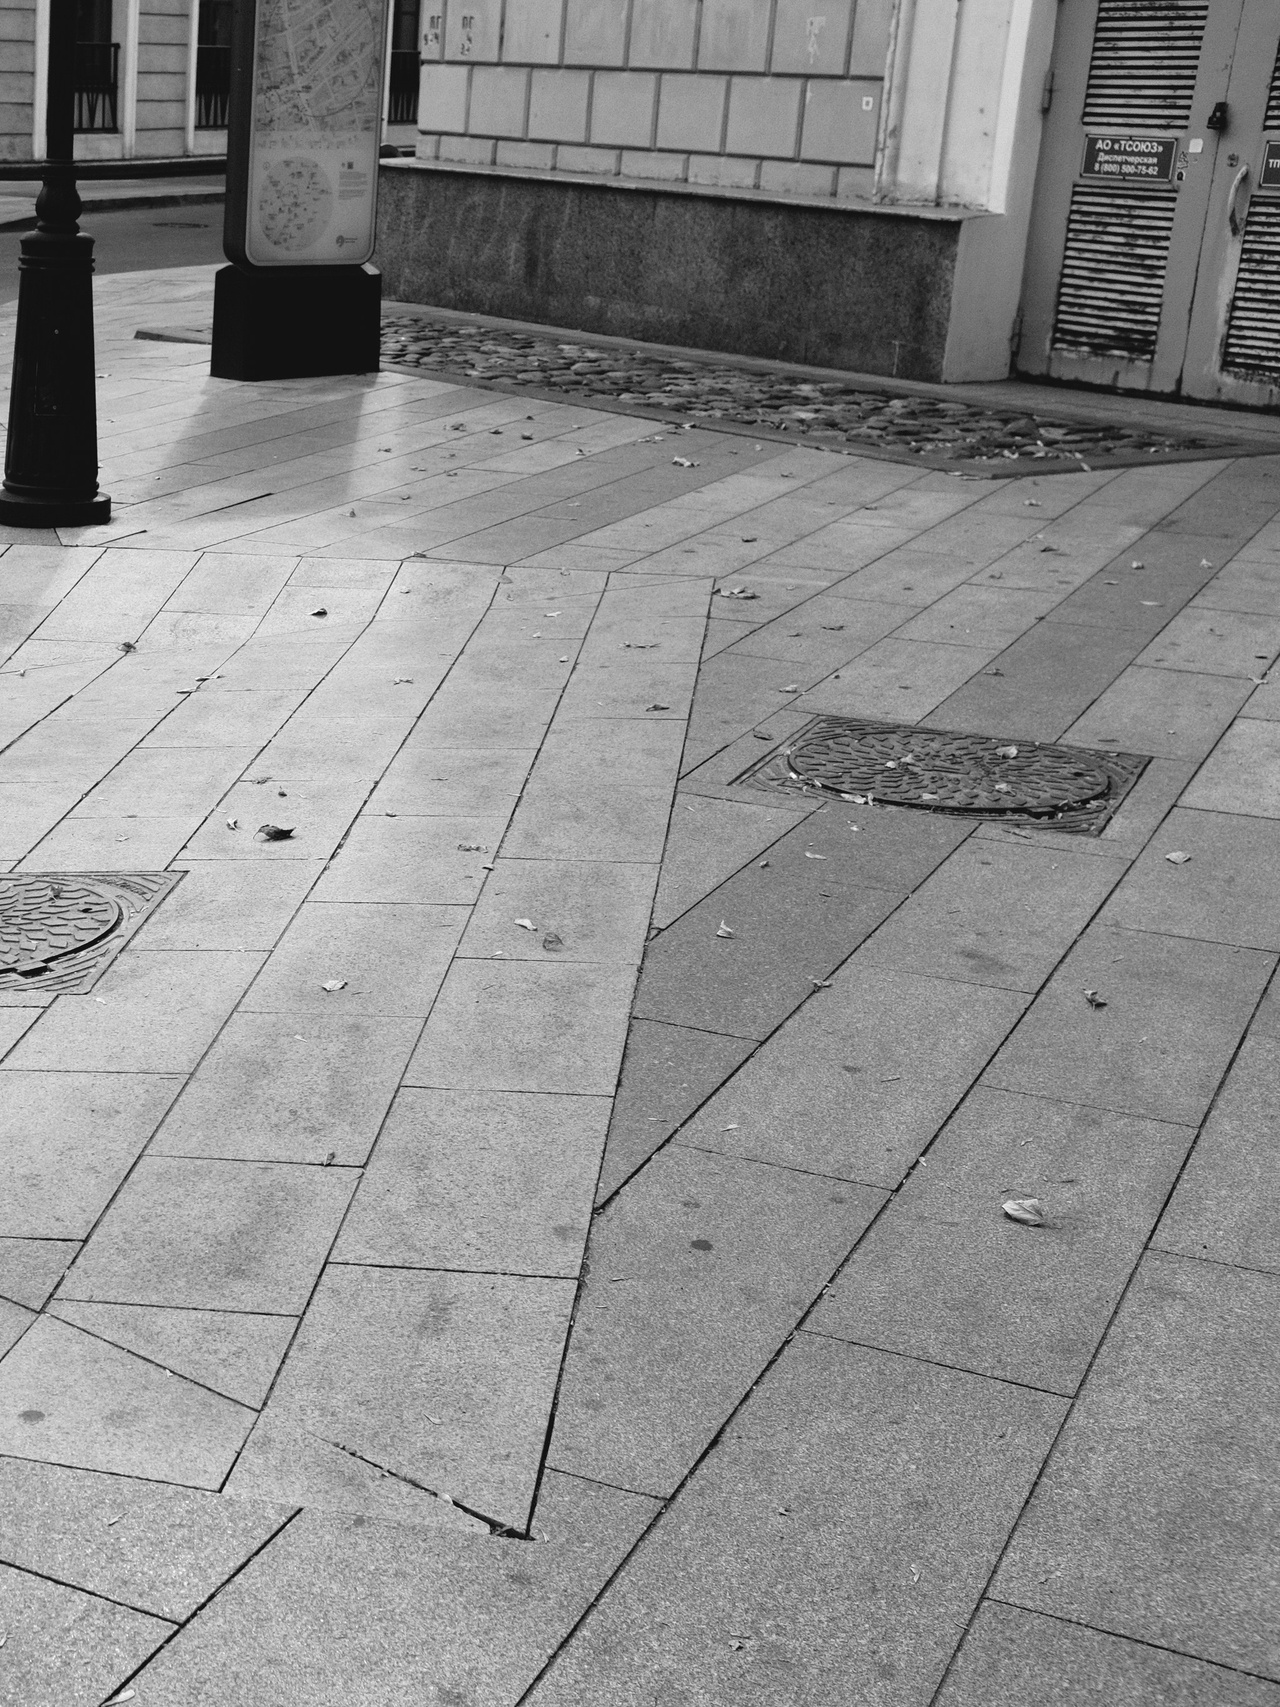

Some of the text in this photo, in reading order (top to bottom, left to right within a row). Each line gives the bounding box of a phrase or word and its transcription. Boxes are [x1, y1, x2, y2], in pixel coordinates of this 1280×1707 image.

[1095, 139, 1163, 153] АО «ТСОЮЗ»
[1097, 152, 1158, 165] Диспетчерская
[1094, 162, 1100, 172] 8
[1100, 163, 1120, 174] (800)
